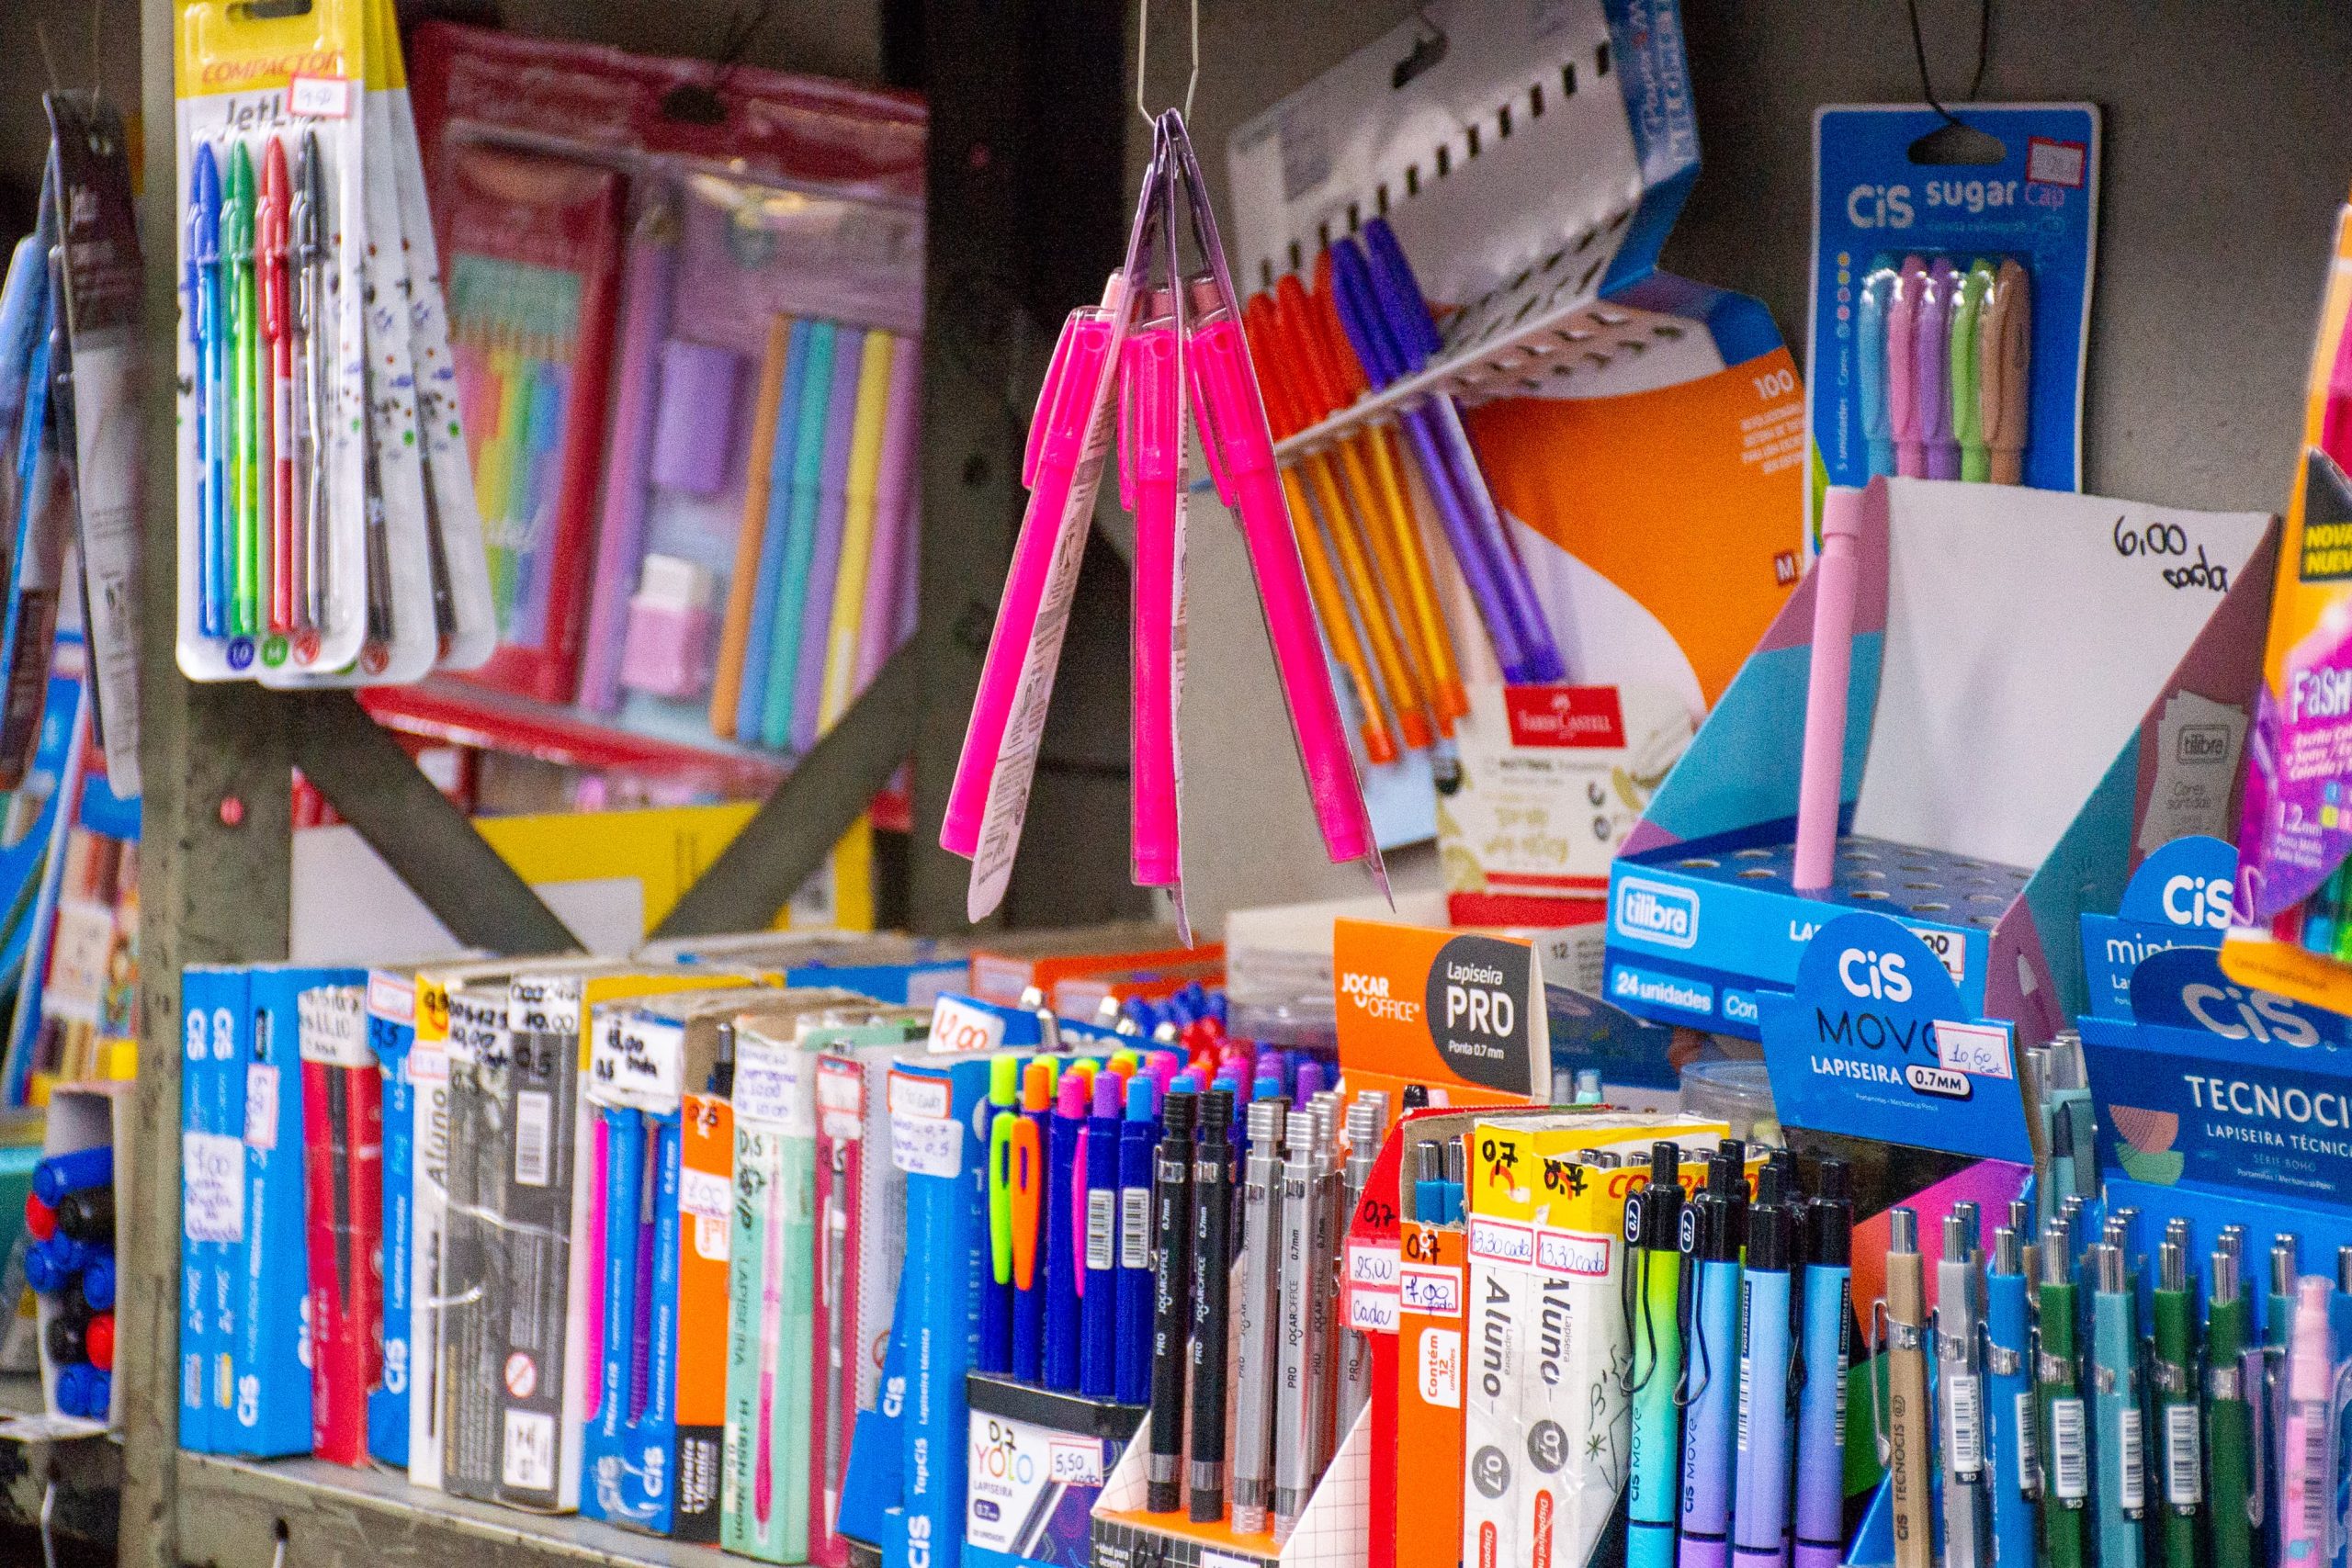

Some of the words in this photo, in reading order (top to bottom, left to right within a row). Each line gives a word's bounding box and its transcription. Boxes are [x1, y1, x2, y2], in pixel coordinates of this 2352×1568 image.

[1847, 184, 1917, 229] CiS
[1927, 181, 2018, 212] sugar
[1754, 369, 1794, 400] 100
[2114, 515, 2188, 556] 6,00
[1625, 894, 1689, 934] tilibra
[2162, 874, 2233, 930] CiS
[1341, 972, 1390, 999] JOCAR
[1446, 961, 1503, 987] Lapiseira
[1617, 970, 1638, 996] 24
[1639, 981, 1712, 1011] unidades
[1838, 947, 1913, 1003] CiS
[1367, 998, 1415, 1022] OFFICE
[1446, 986, 1514, 1037] PRO
[2182, 983, 2321, 1049] CiS
[1448, 1040, 1473, 1056] Ponta
[1474, 1043, 1487, 1056] 0.7
[1487, 1047, 1505, 1060] mm
[1811, 1055, 1904, 1086] LAPISEIRA
[1915, 1070, 1962, 1091] 0.7MM
[424, 1088, 447, 1192] Aluno
[2207, 1122, 2284, 1148] LAPISEIRA
[1162, 1199, 1170, 1231] 0.7mm
[1363, 1200, 1396, 1228] 0,7
[1628, 1209, 1637, 1233] 0.7
[1683, 1221, 1692, 1243] 0.7
[1291, 1229, 1299, 1260] 0.7mm
[1407, 1234, 1441, 1265] 0,7
[1355, 1255, 1393, 1281] 25,00
[735, 1257, 749, 1367] LAPISEIRA
[919, 1327, 932, 1371] técnica
[1157, 1332, 1166, 1356] PRO
[1194, 1341, 1204, 1365] PRO
[1484, 1276, 1512, 1397] Aluno
[1505, 1328, 1514, 1375] Lapiseira
[1563, 1316, 1573, 1363] Lapiseira
[384, 1338, 408, 1394] CiS
[1287, 1366, 1296, 1389] PRO
[1348, 1359, 1359, 1382] PRO
[1428, 1334, 1439, 1397] Contém
[1439, 1359, 1449, 1376] 12
[1448, 1348, 1456, 1391] unidades
[237, 1374, 260, 1427] CiS
[883, 1376, 906, 1418] CiS
[919, 1372, 931, 1426] Lapiseira
[913, 1438, 930, 1495] TapCiS
[975, 1442, 1035, 1485] YOLO
[1056, 1452, 1084, 1475] 5,50
[1543, 1428, 1560, 1466] 0,7
[1894, 1424, 1906, 1503] TECNOCIS
[643, 1445, 664, 1497] CiS
[680, 1437, 696, 1514] Lapiseira
[973, 1480, 1013, 1498] LAPISEIRA
[1486, 1454, 1503, 1492] 0,7
[1631, 1472, 1640, 1503] CiS
[1684, 1483, 1694, 1514] CiS
[907, 1514, 932, 1568] CiS
[1537, 1498, 1550, 1557] Disponível
[1896, 1513, 1908, 1541] CiS
